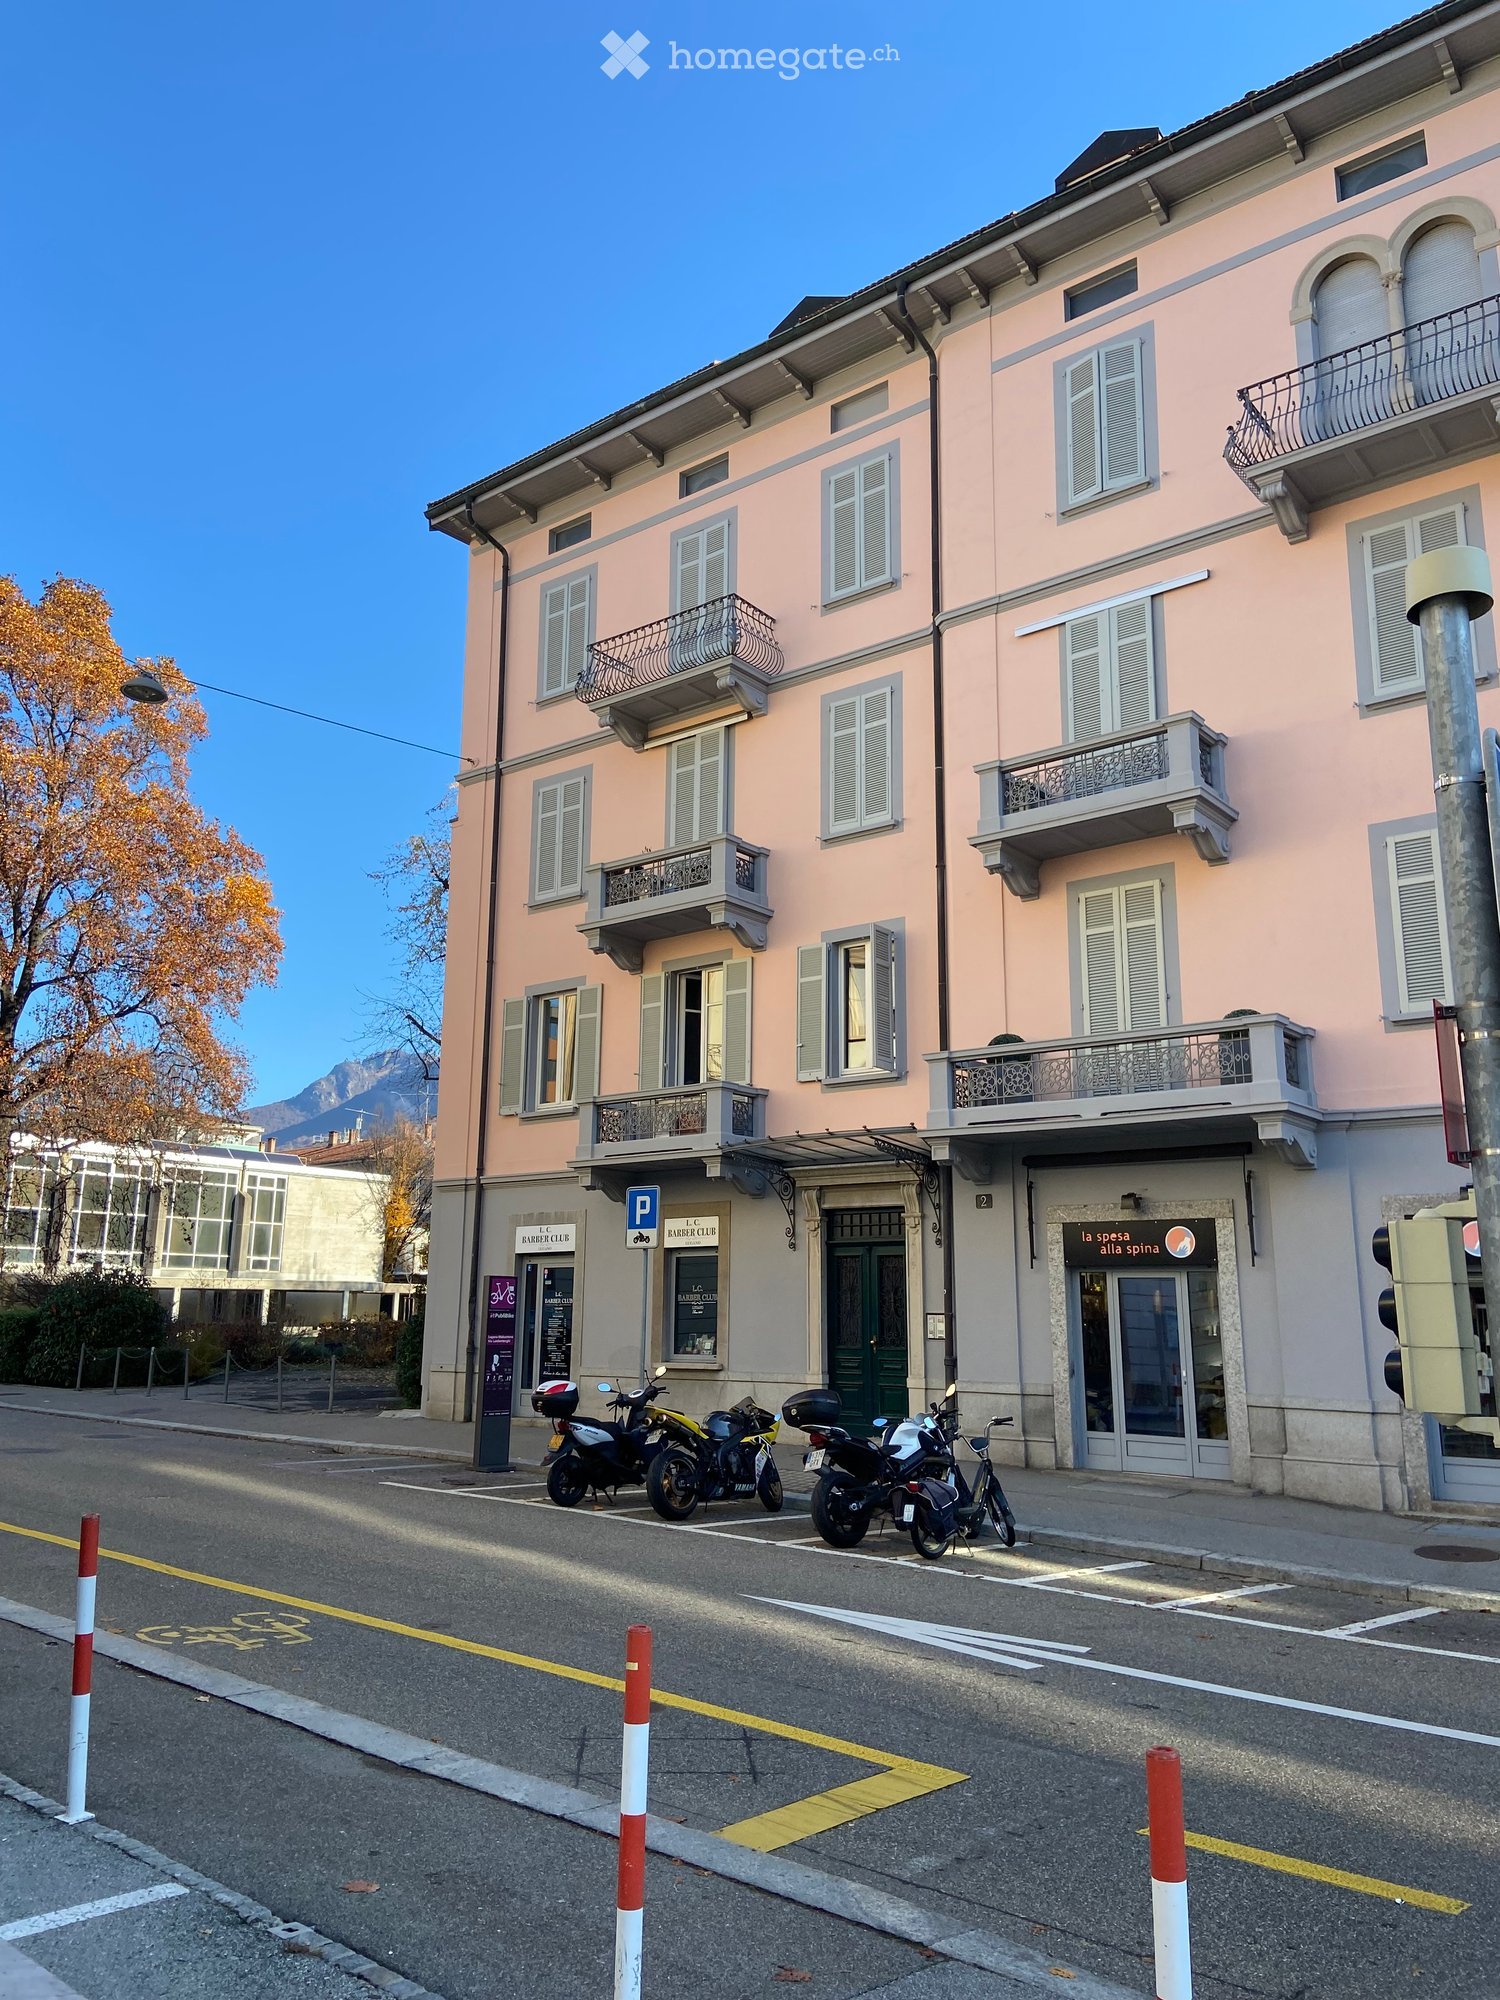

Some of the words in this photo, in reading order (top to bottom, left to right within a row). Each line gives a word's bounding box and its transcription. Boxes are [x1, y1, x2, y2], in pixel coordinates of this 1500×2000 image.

[980, 1195, 987, 1206] 2
[636, 1196, 650, 1224] P
[522, 1235, 549, 1243] BARBER
[550, 1234, 569, 1242] CLUB
[668, 1228, 695, 1238] BARBER
[697, 1227, 716, 1236] CLUB
[1082, 1231, 1092, 1242] la
[1096, 1232, 1130, 1244] spesa
[1100, 1243, 1122, 1255] alla
[1126, 1242, 1160, 1256] spina
